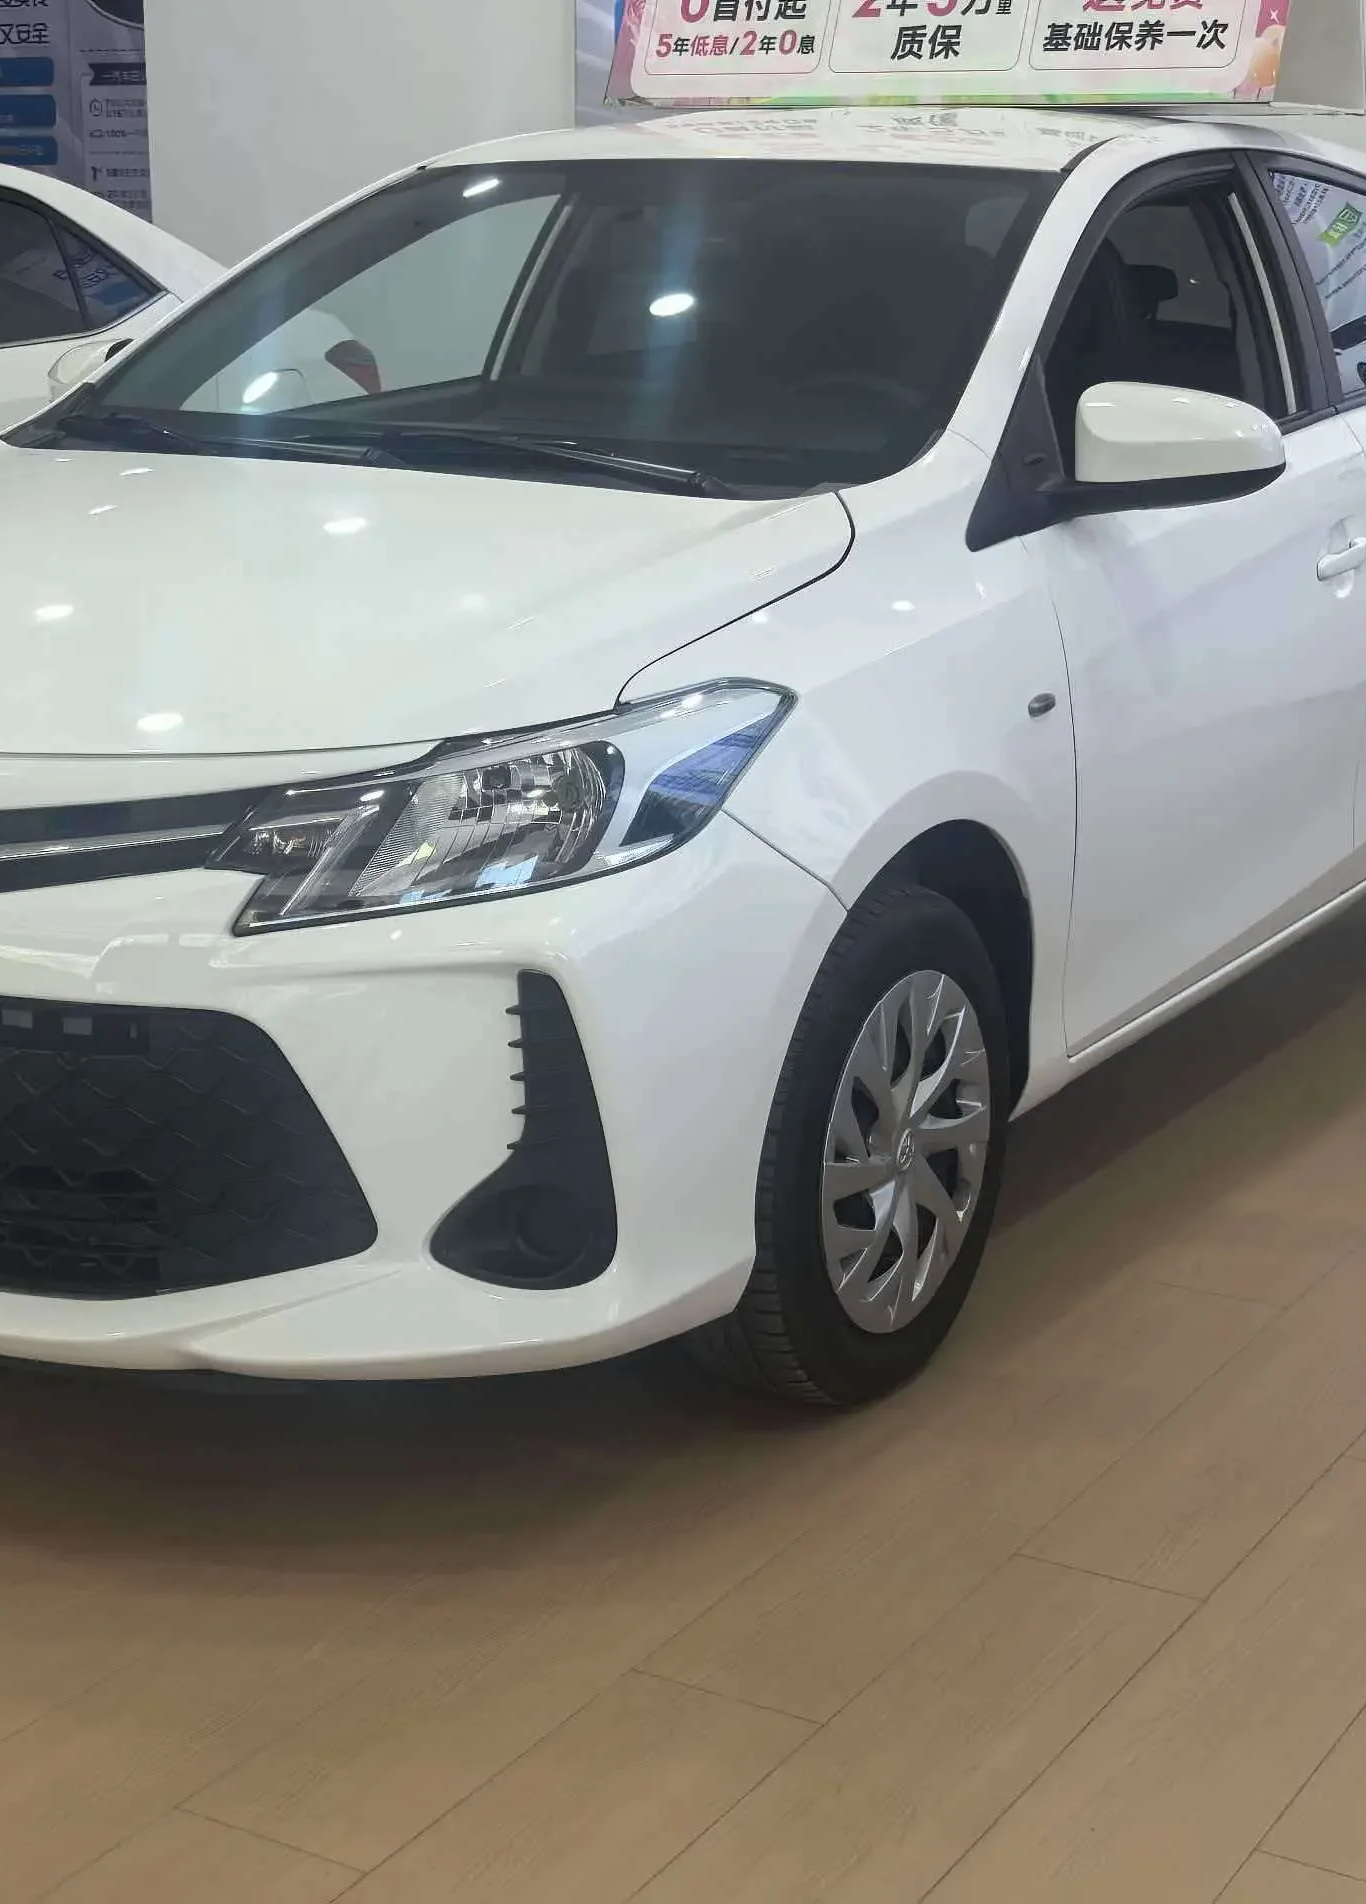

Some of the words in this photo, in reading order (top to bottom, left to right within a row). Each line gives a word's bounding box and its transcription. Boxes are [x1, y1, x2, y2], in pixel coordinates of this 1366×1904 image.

[655, 29, 816, 58] 5年低息/2年0息
[890, 24, 963, 61] 质保
[1042, 18, 1229, 52] 基础保养一次
